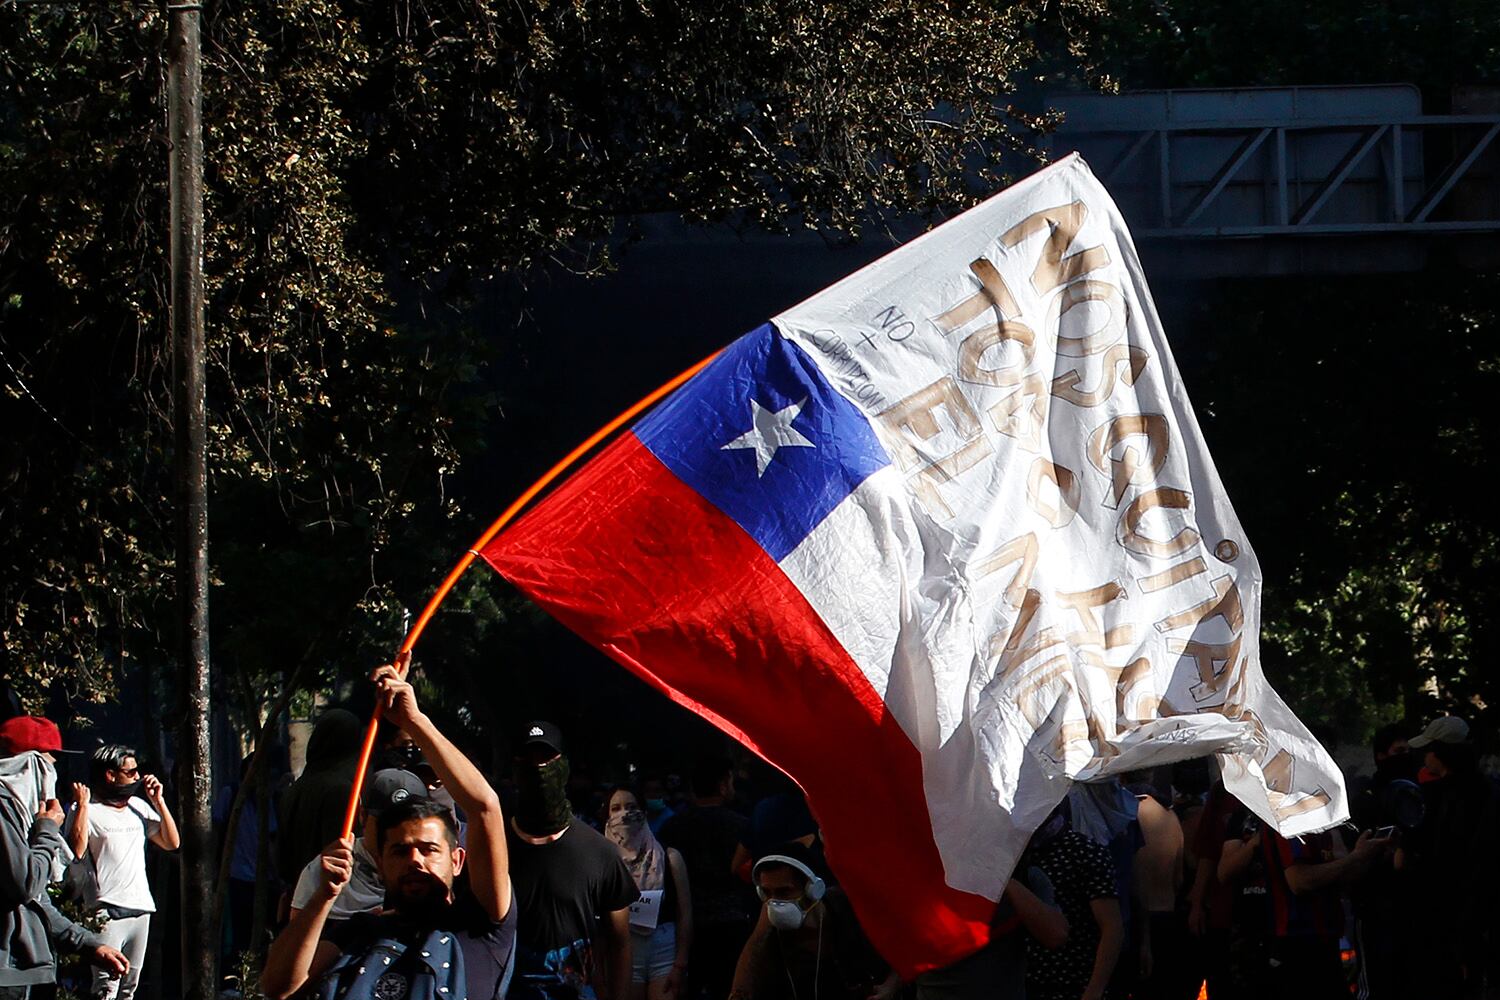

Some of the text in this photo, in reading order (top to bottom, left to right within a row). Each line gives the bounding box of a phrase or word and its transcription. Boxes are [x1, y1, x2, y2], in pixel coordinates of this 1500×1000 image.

[855, 330, 878, 351] +
[874, 305, 915, 342] NO
[999, 199, 1149, 408] NOS
[874, 373, 996, 522] EL
